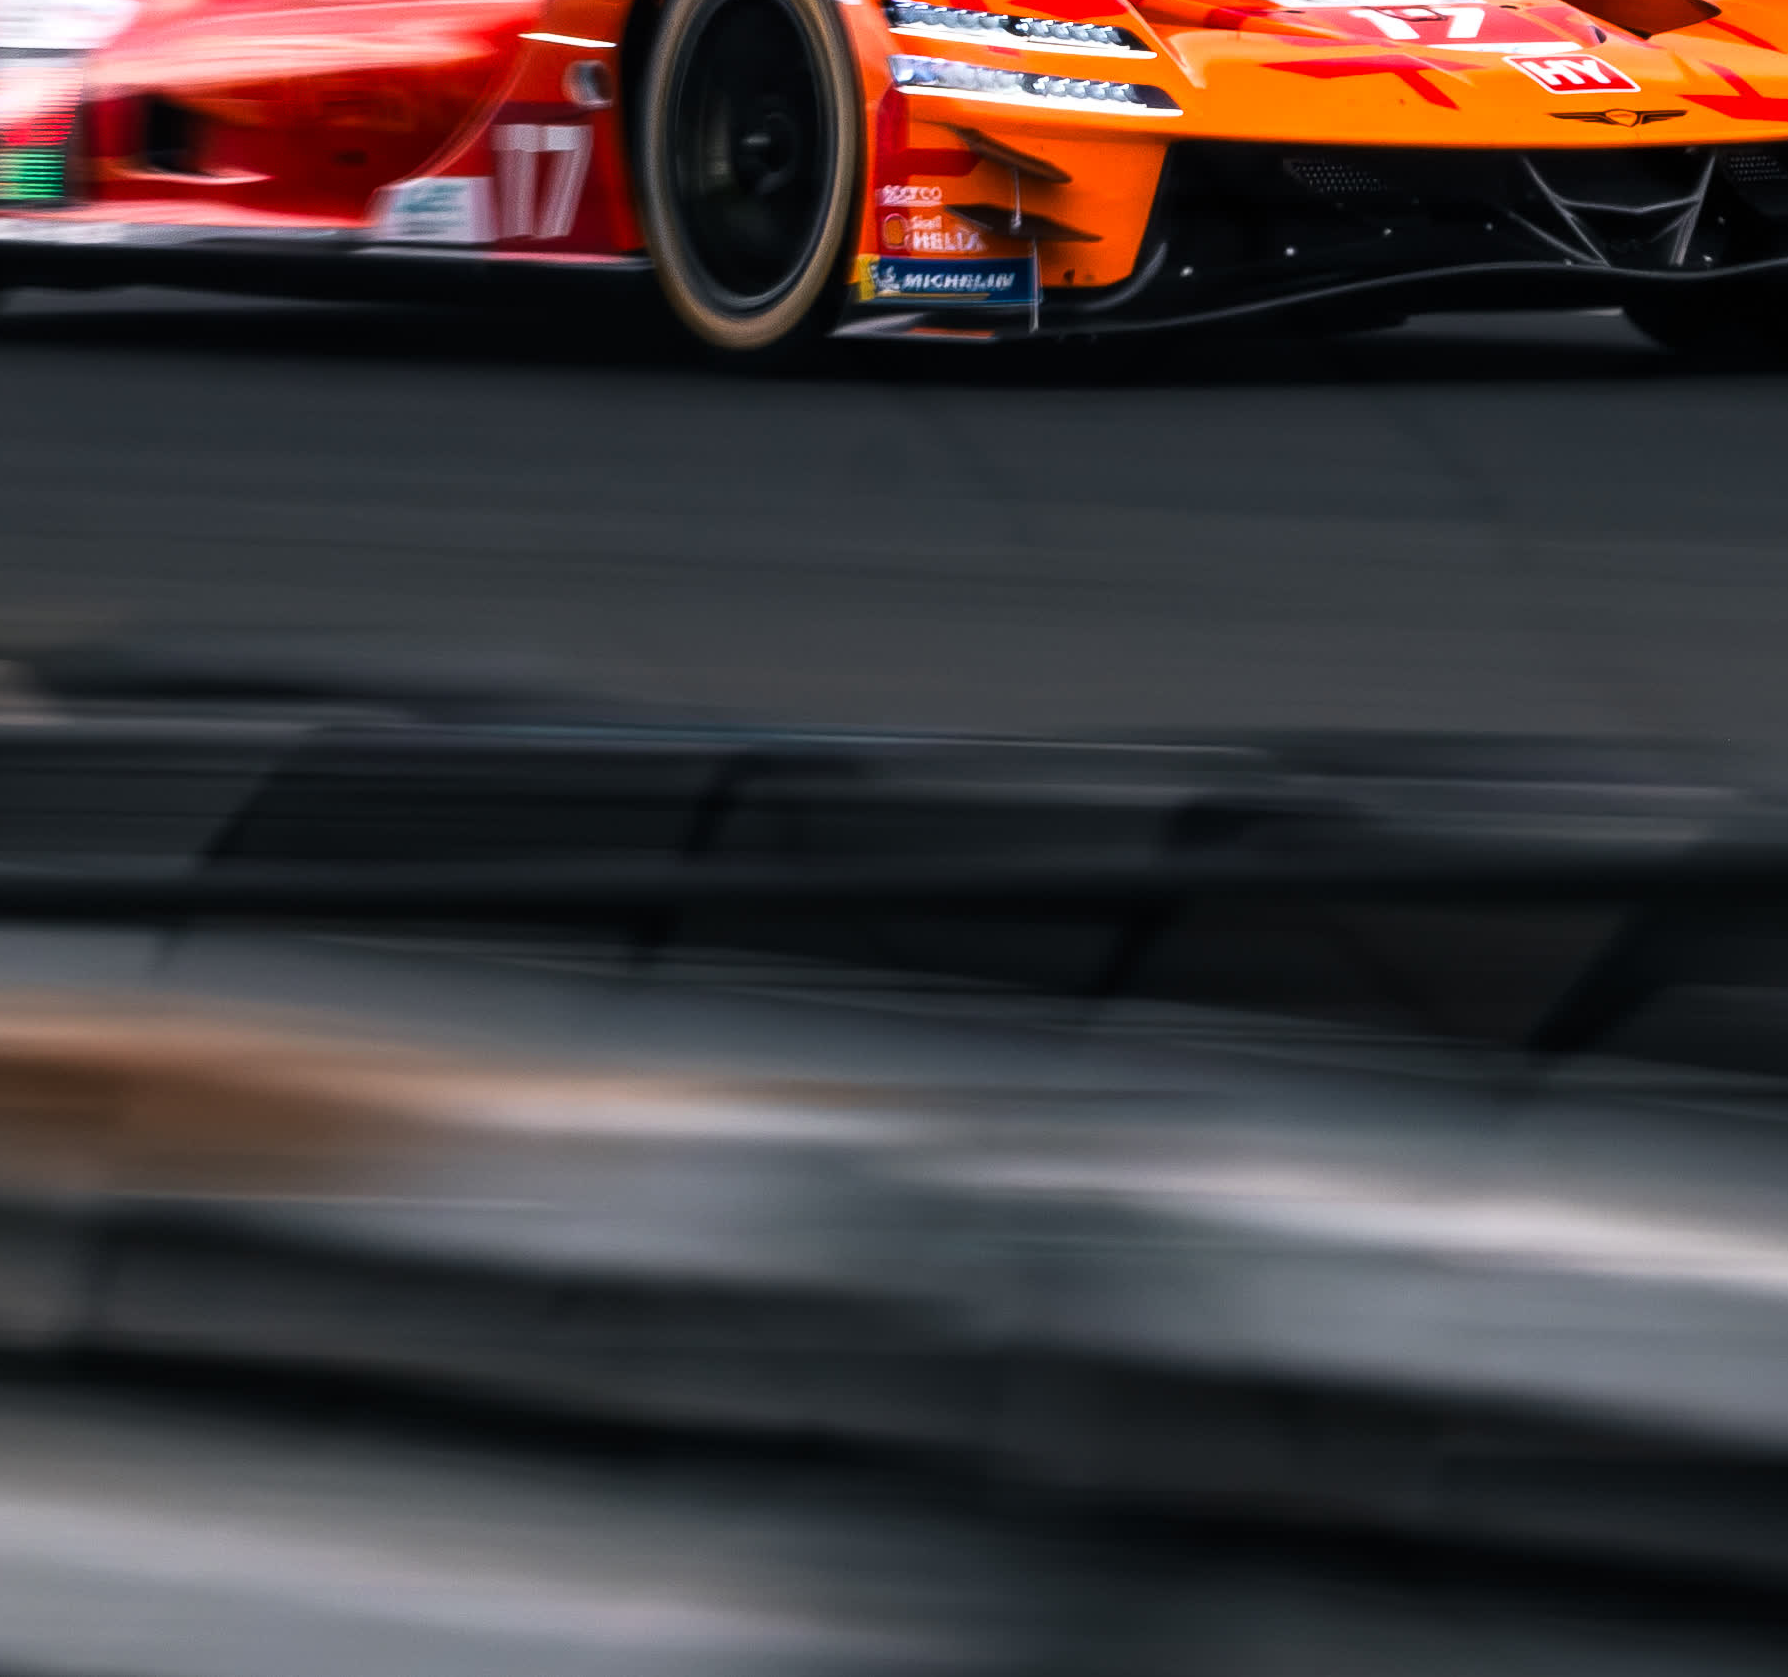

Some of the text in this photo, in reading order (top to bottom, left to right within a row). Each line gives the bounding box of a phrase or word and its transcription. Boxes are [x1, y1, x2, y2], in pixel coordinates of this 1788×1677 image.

[1350, 8, 1486, 39] 17
[1523, 59, 1613, 86] HY
[490, 124, 593, 238] 17
[902, 273, 1015, 292] MICHELIN
